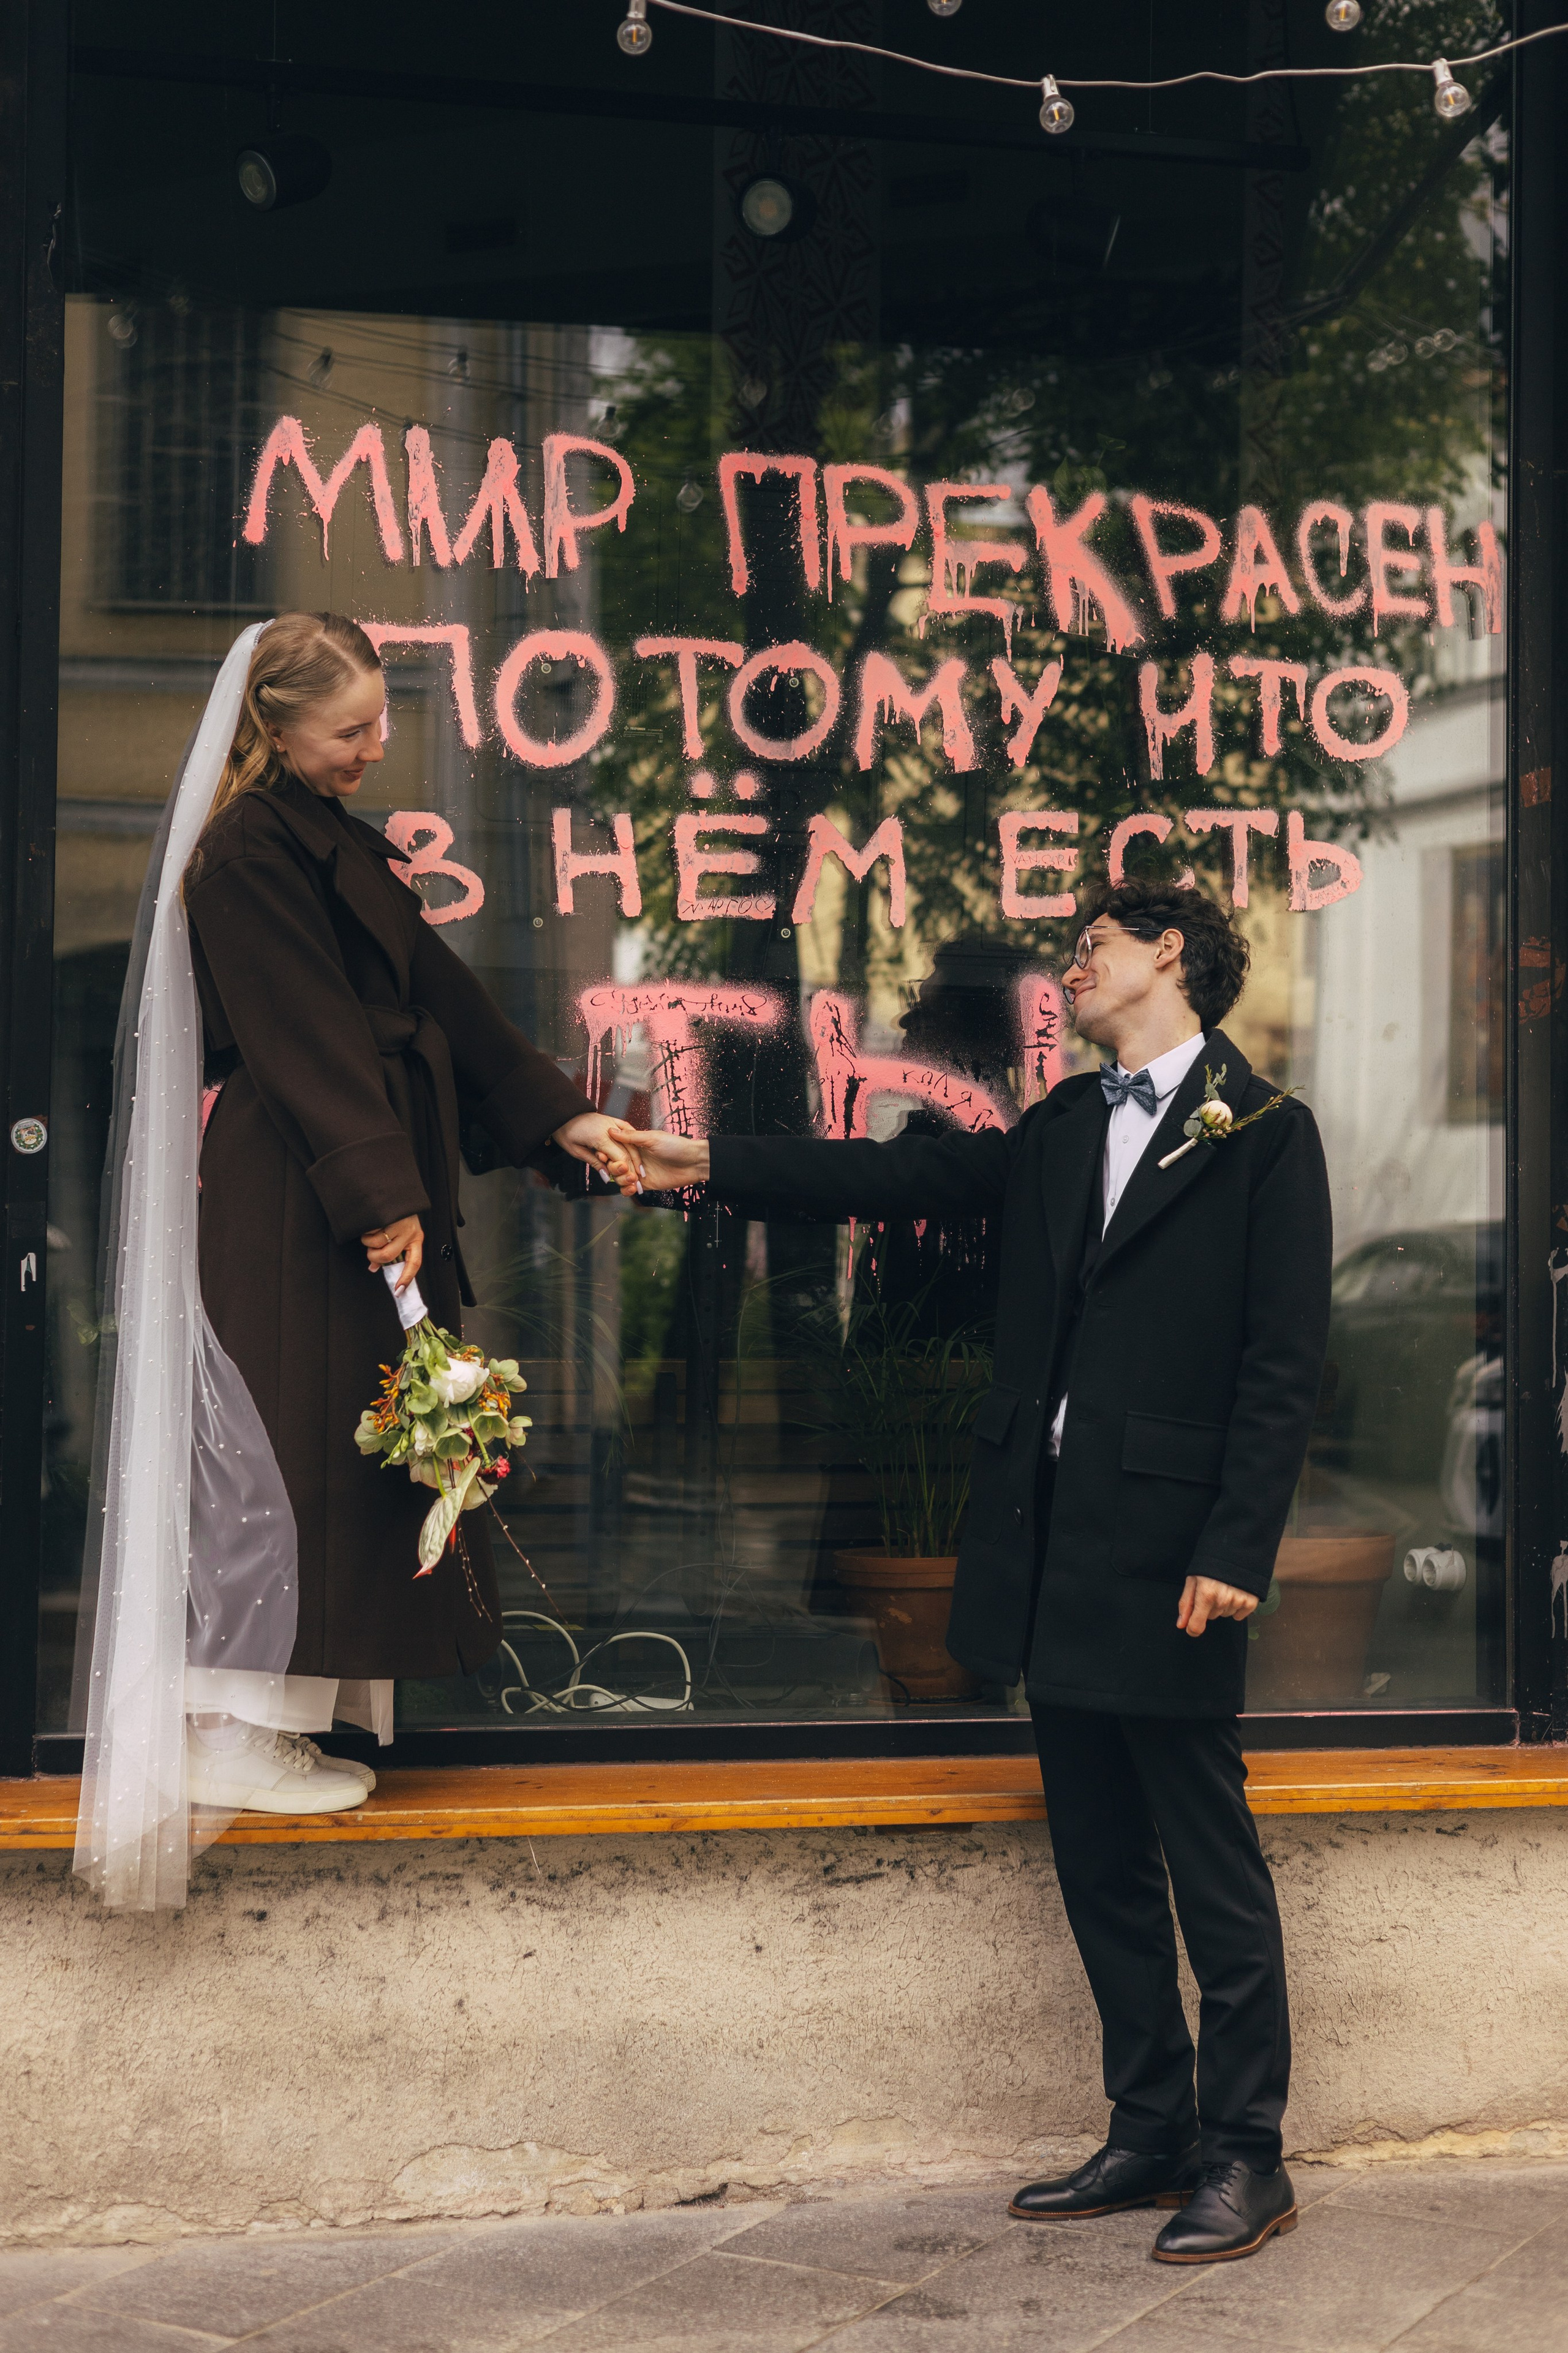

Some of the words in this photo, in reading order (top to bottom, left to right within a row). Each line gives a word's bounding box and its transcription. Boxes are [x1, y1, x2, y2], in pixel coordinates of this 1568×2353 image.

[243, 415, 636, 580] МИР
[718, 452, 1502, 653] ПРЕКРАСЕН
[360, 621, 1062, 775] ПОТОМУ
[1138, 652, 1410, 780] ЧТО
[384, 810, 485, 926] В
[552, 769, 905, 927] НЁМ
[998, 809, 1364, 918] ЕСТЬ
[578, 978, 1065, 1142] ТЫ
